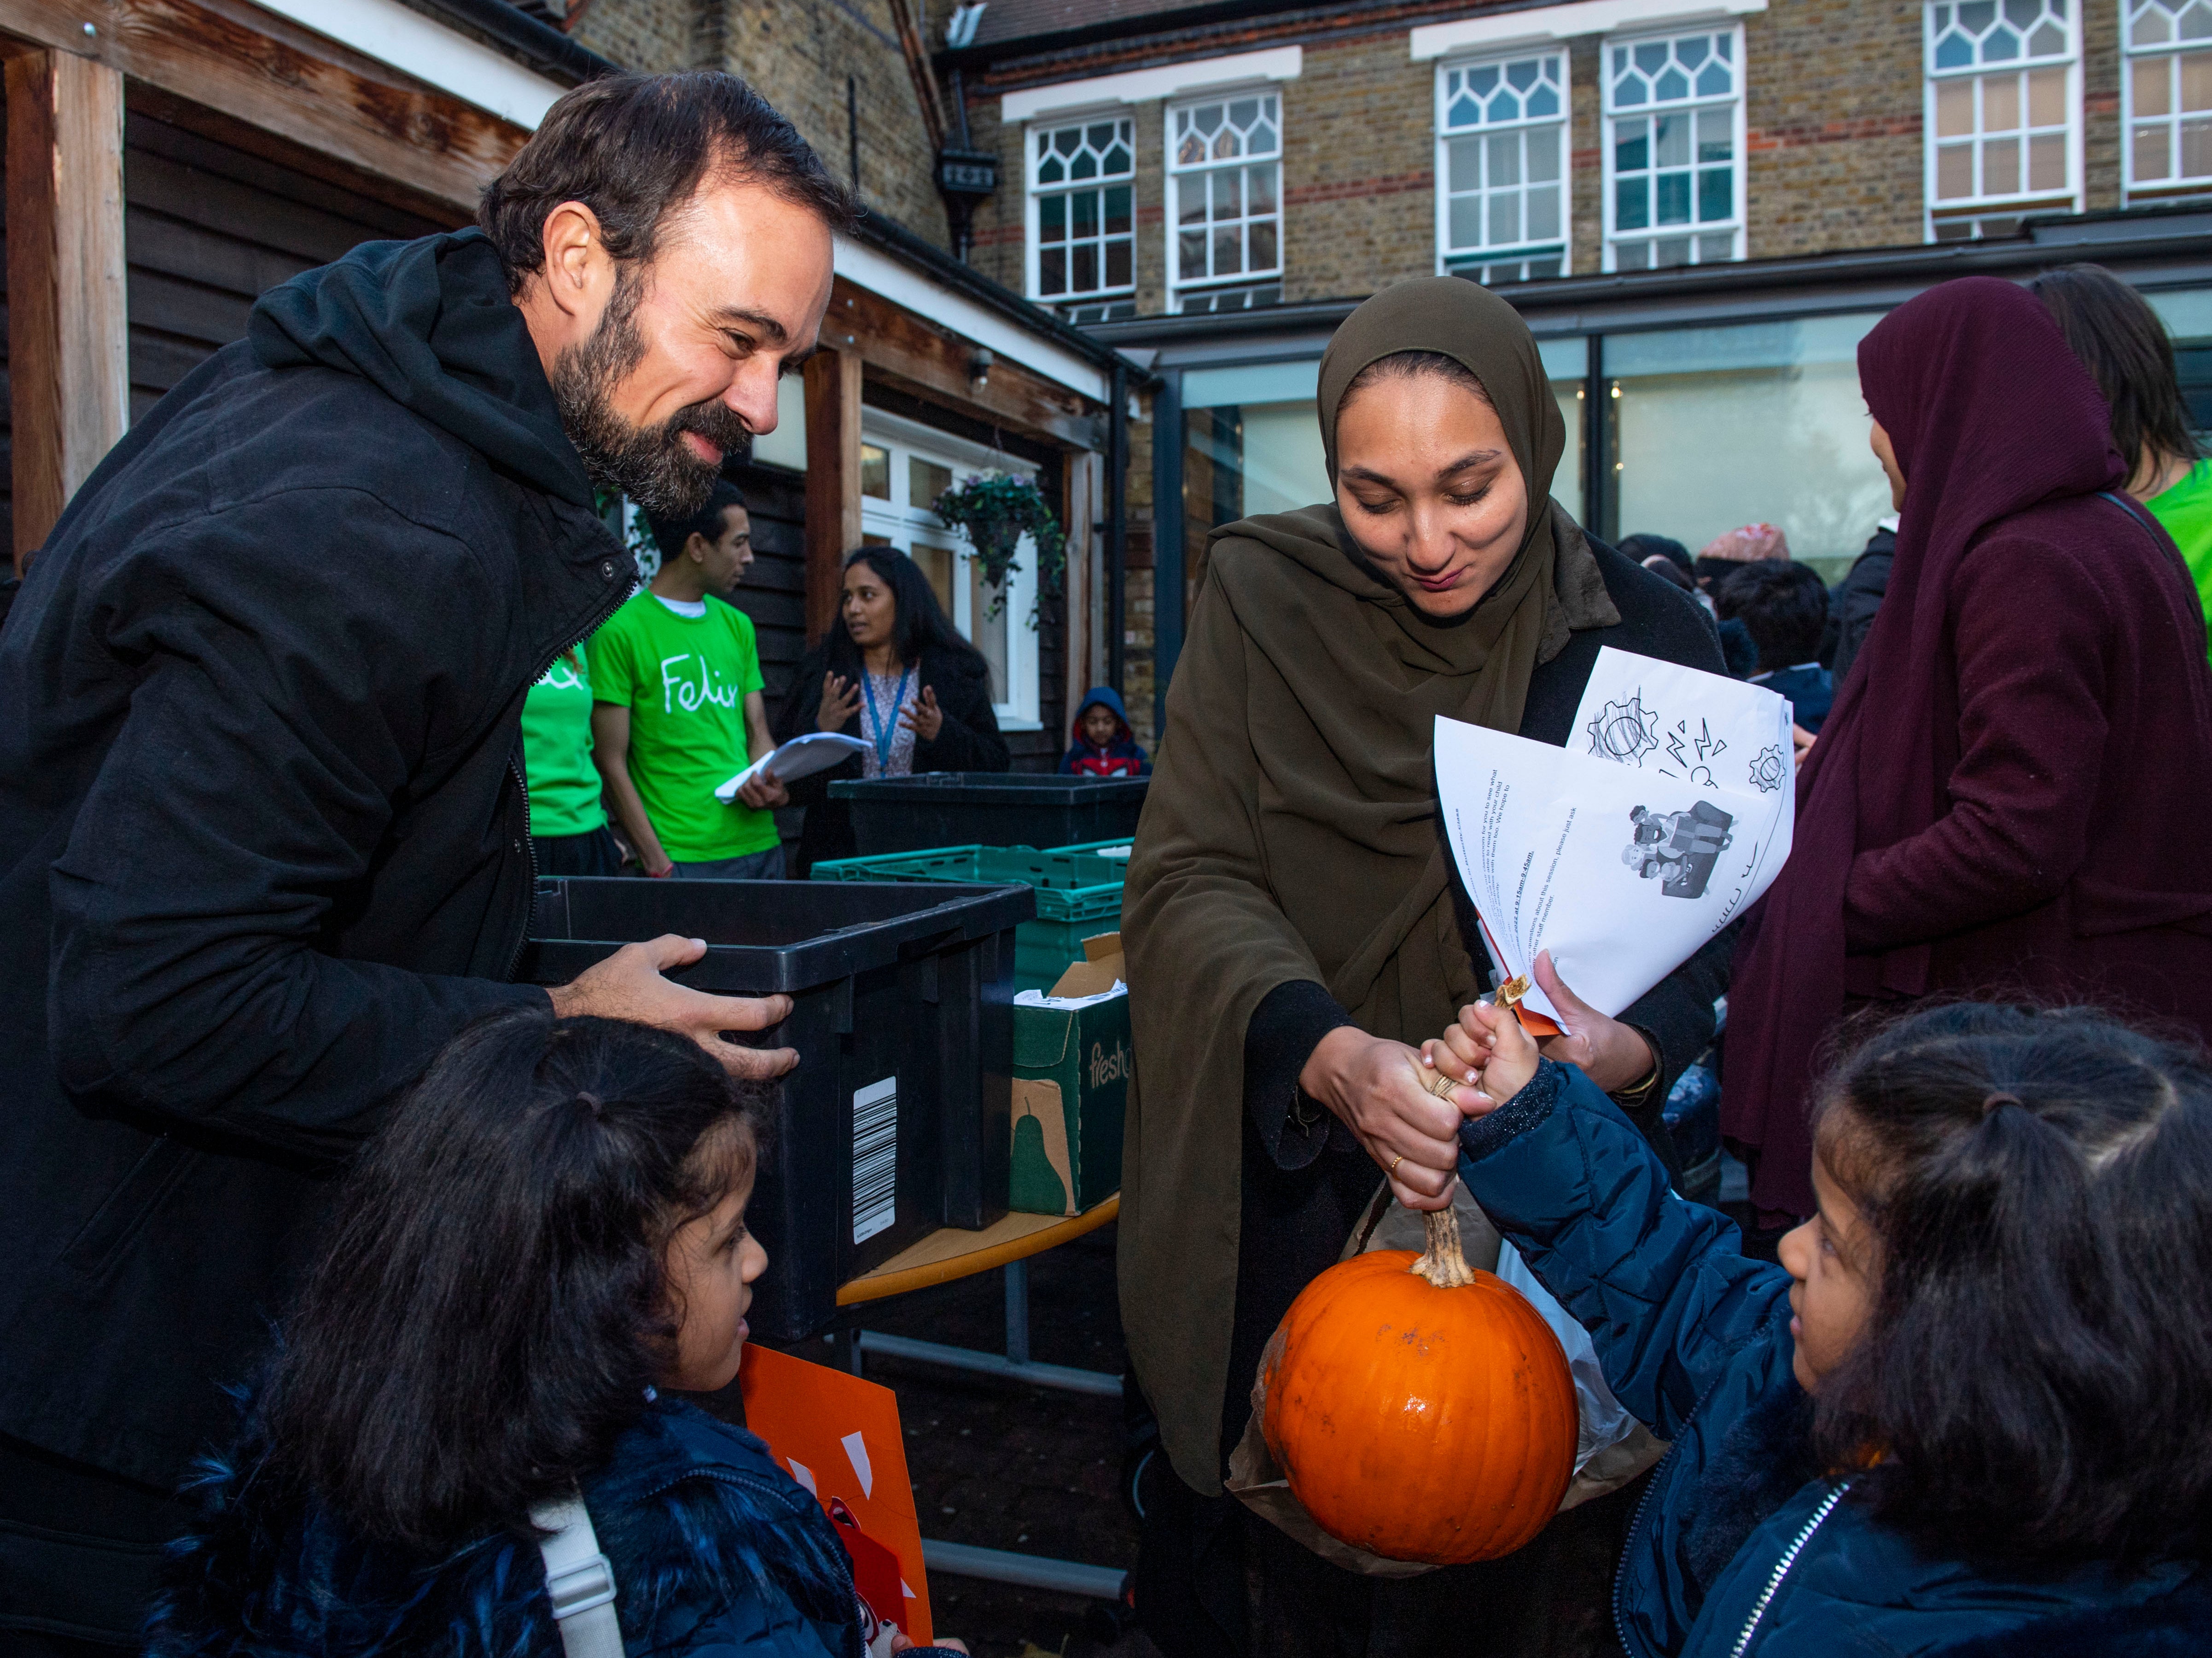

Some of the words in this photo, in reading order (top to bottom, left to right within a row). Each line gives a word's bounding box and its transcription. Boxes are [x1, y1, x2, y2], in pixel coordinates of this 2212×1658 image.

[661, 653, 738, 714] Felix
[1496, 812, 1502, 823] We
[1499, 793, 1508, 810] hope
[1514, 851, 1534, 906] 9:15am-9:45am.
[1528, 917, 1538, 949] questions
[1535, 897, 1545, 916] about
[1540, 884, 1549, 896] this
[1546, 857, 1560, 883] session,
[1556, 833, 1567, 855] please
[1562, 820, 1572, 833] just
[1569, 807, 1577, 819] ask
[1542, 895, 1555, 922] member.
[1089, 1040, 1131, 1089] fresh
